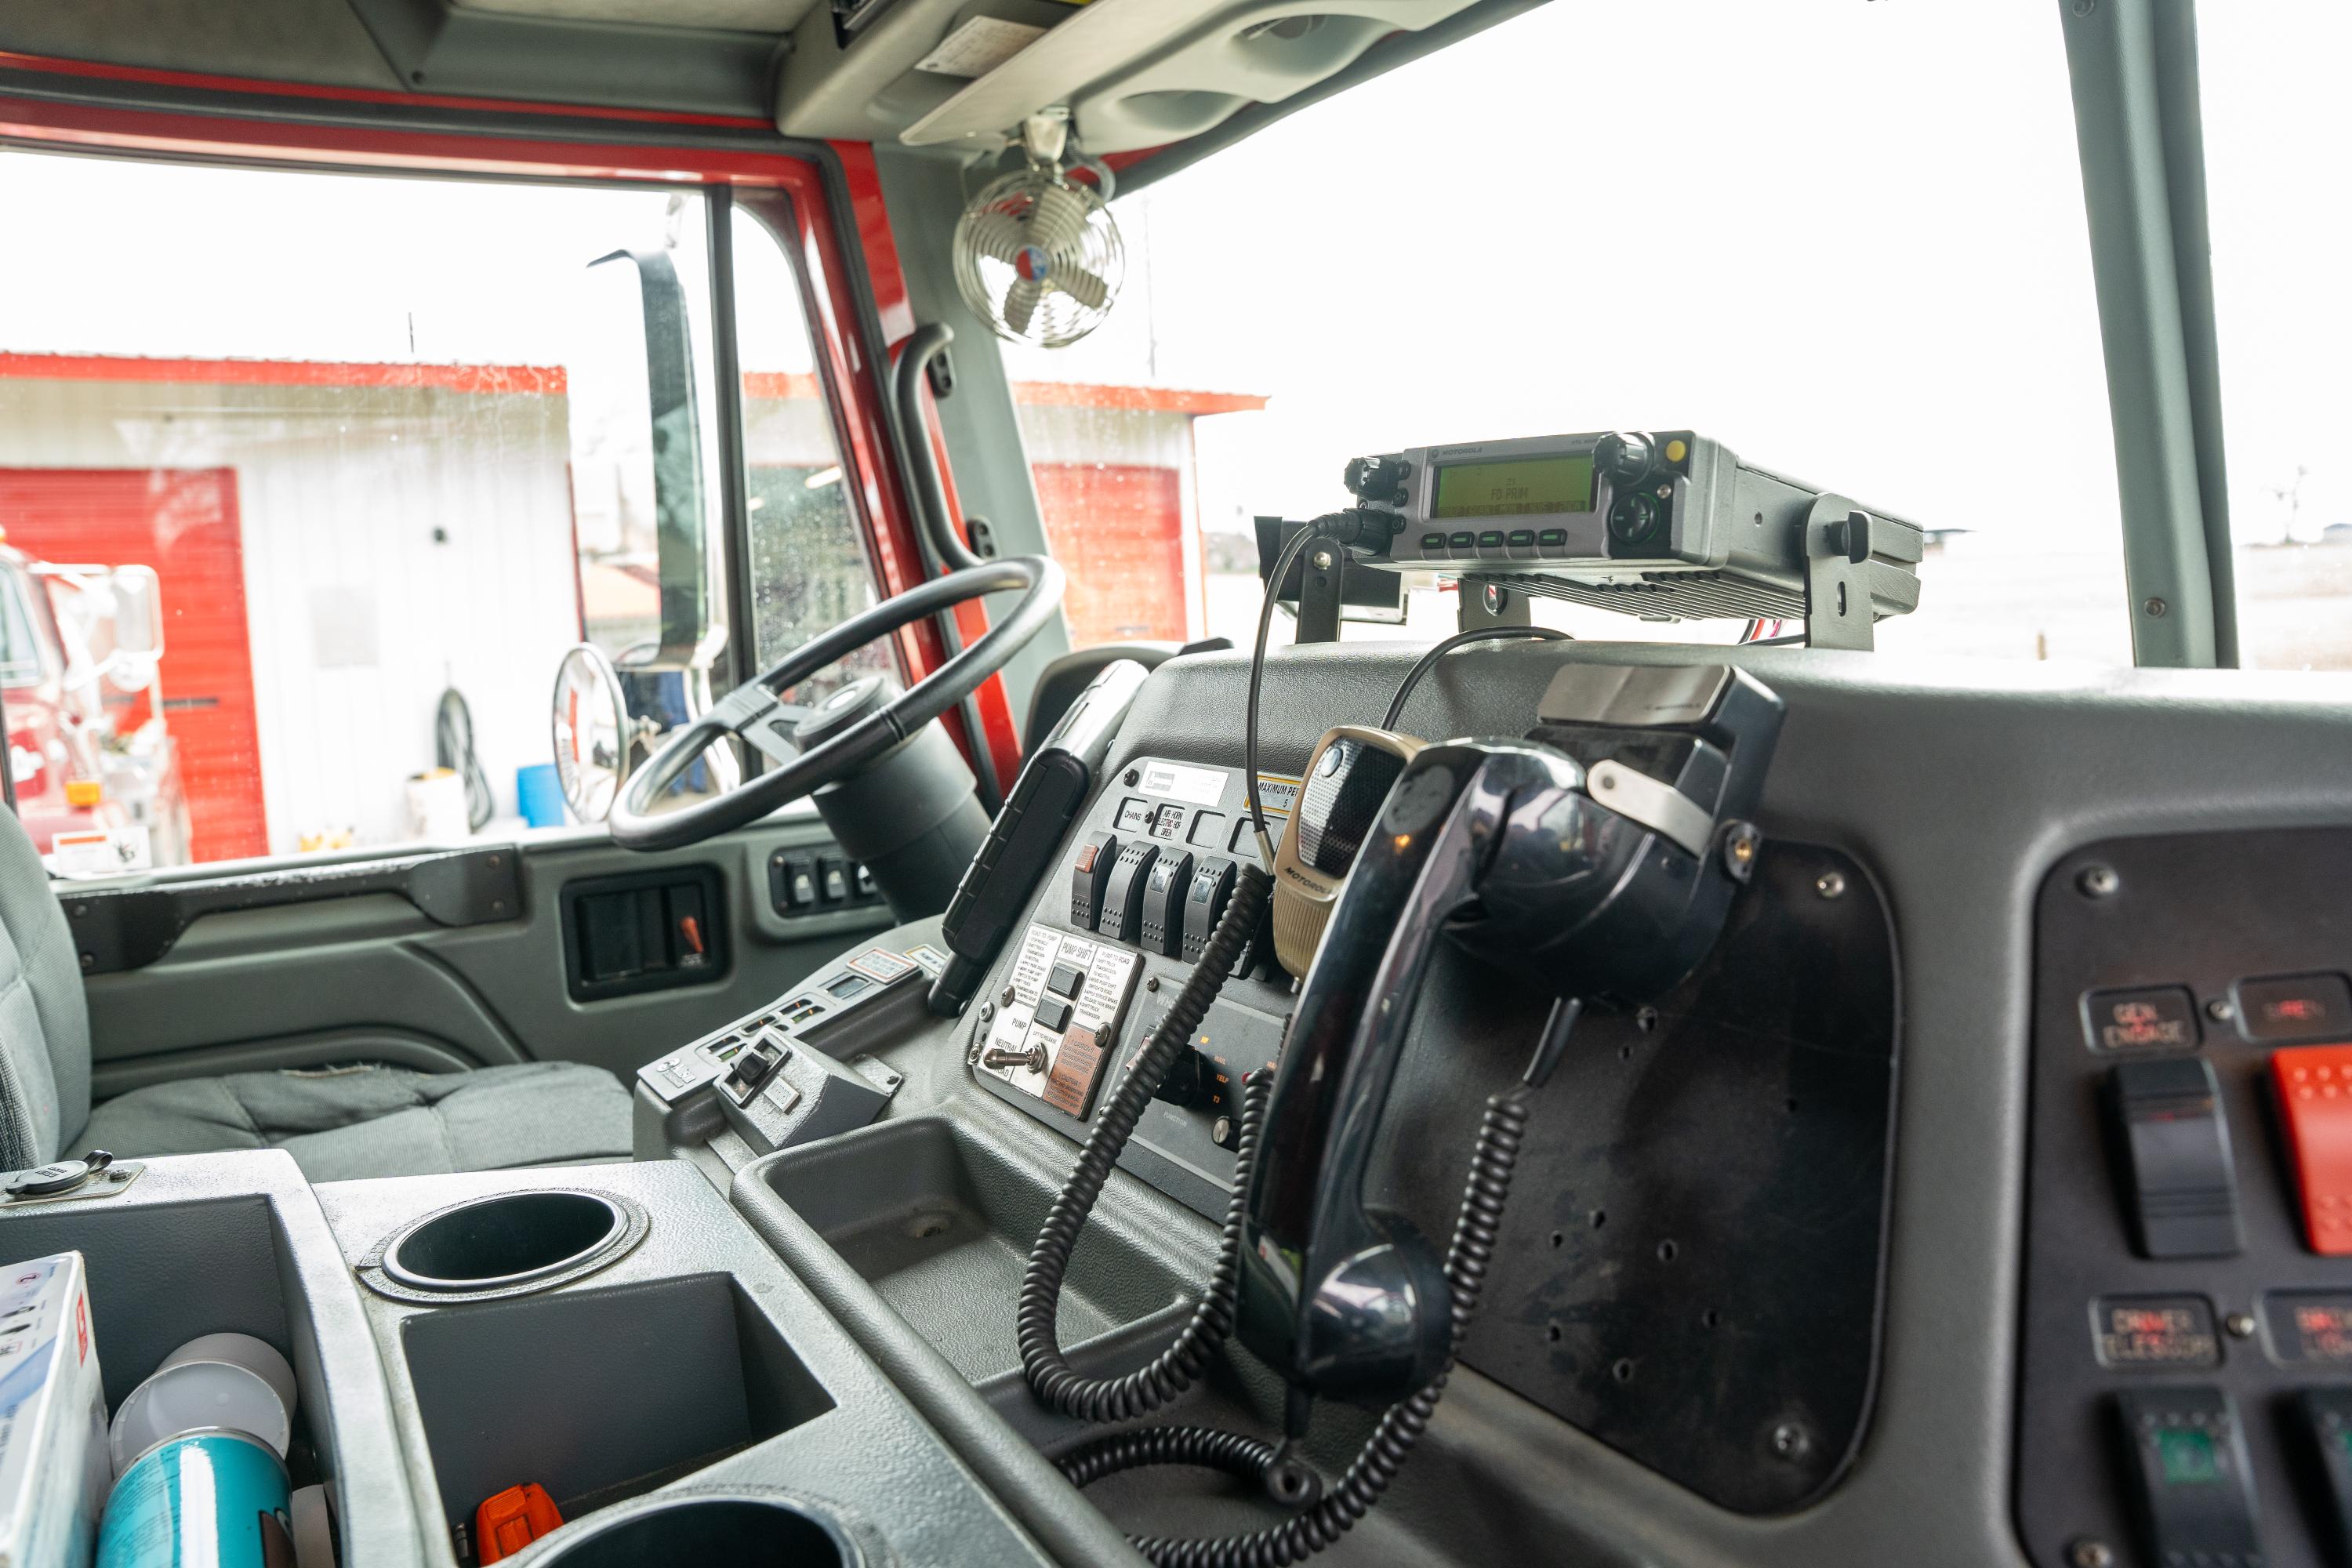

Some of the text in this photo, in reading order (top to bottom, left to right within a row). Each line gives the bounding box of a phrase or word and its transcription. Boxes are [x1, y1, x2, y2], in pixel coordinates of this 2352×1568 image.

[1442, 448, 1483, 456] MOTOROLA
[1505, 487, 1529, 500] PRIM
[1258, 782, 1287, 795] MAXIMUM
[1124, 810, 1142, 821] CHAINS
[1171, 811, 1183, 821] HORN
[1161, 828, 1173, 837] SIREN
[1061, 942, 1093, 960] PUMP SHIFT
[1119, 956, 1131, 965] ROAD
[1084, 996, 1098, 1005] RELEASE
[1105, 1003, 1116, 1011] BRAKE
[1107, 996, 1119, 1005] BRAKE
[1011, 1018, 1027, 1030] PUMP
[1216, 1073, 1230, 1083] YELP
